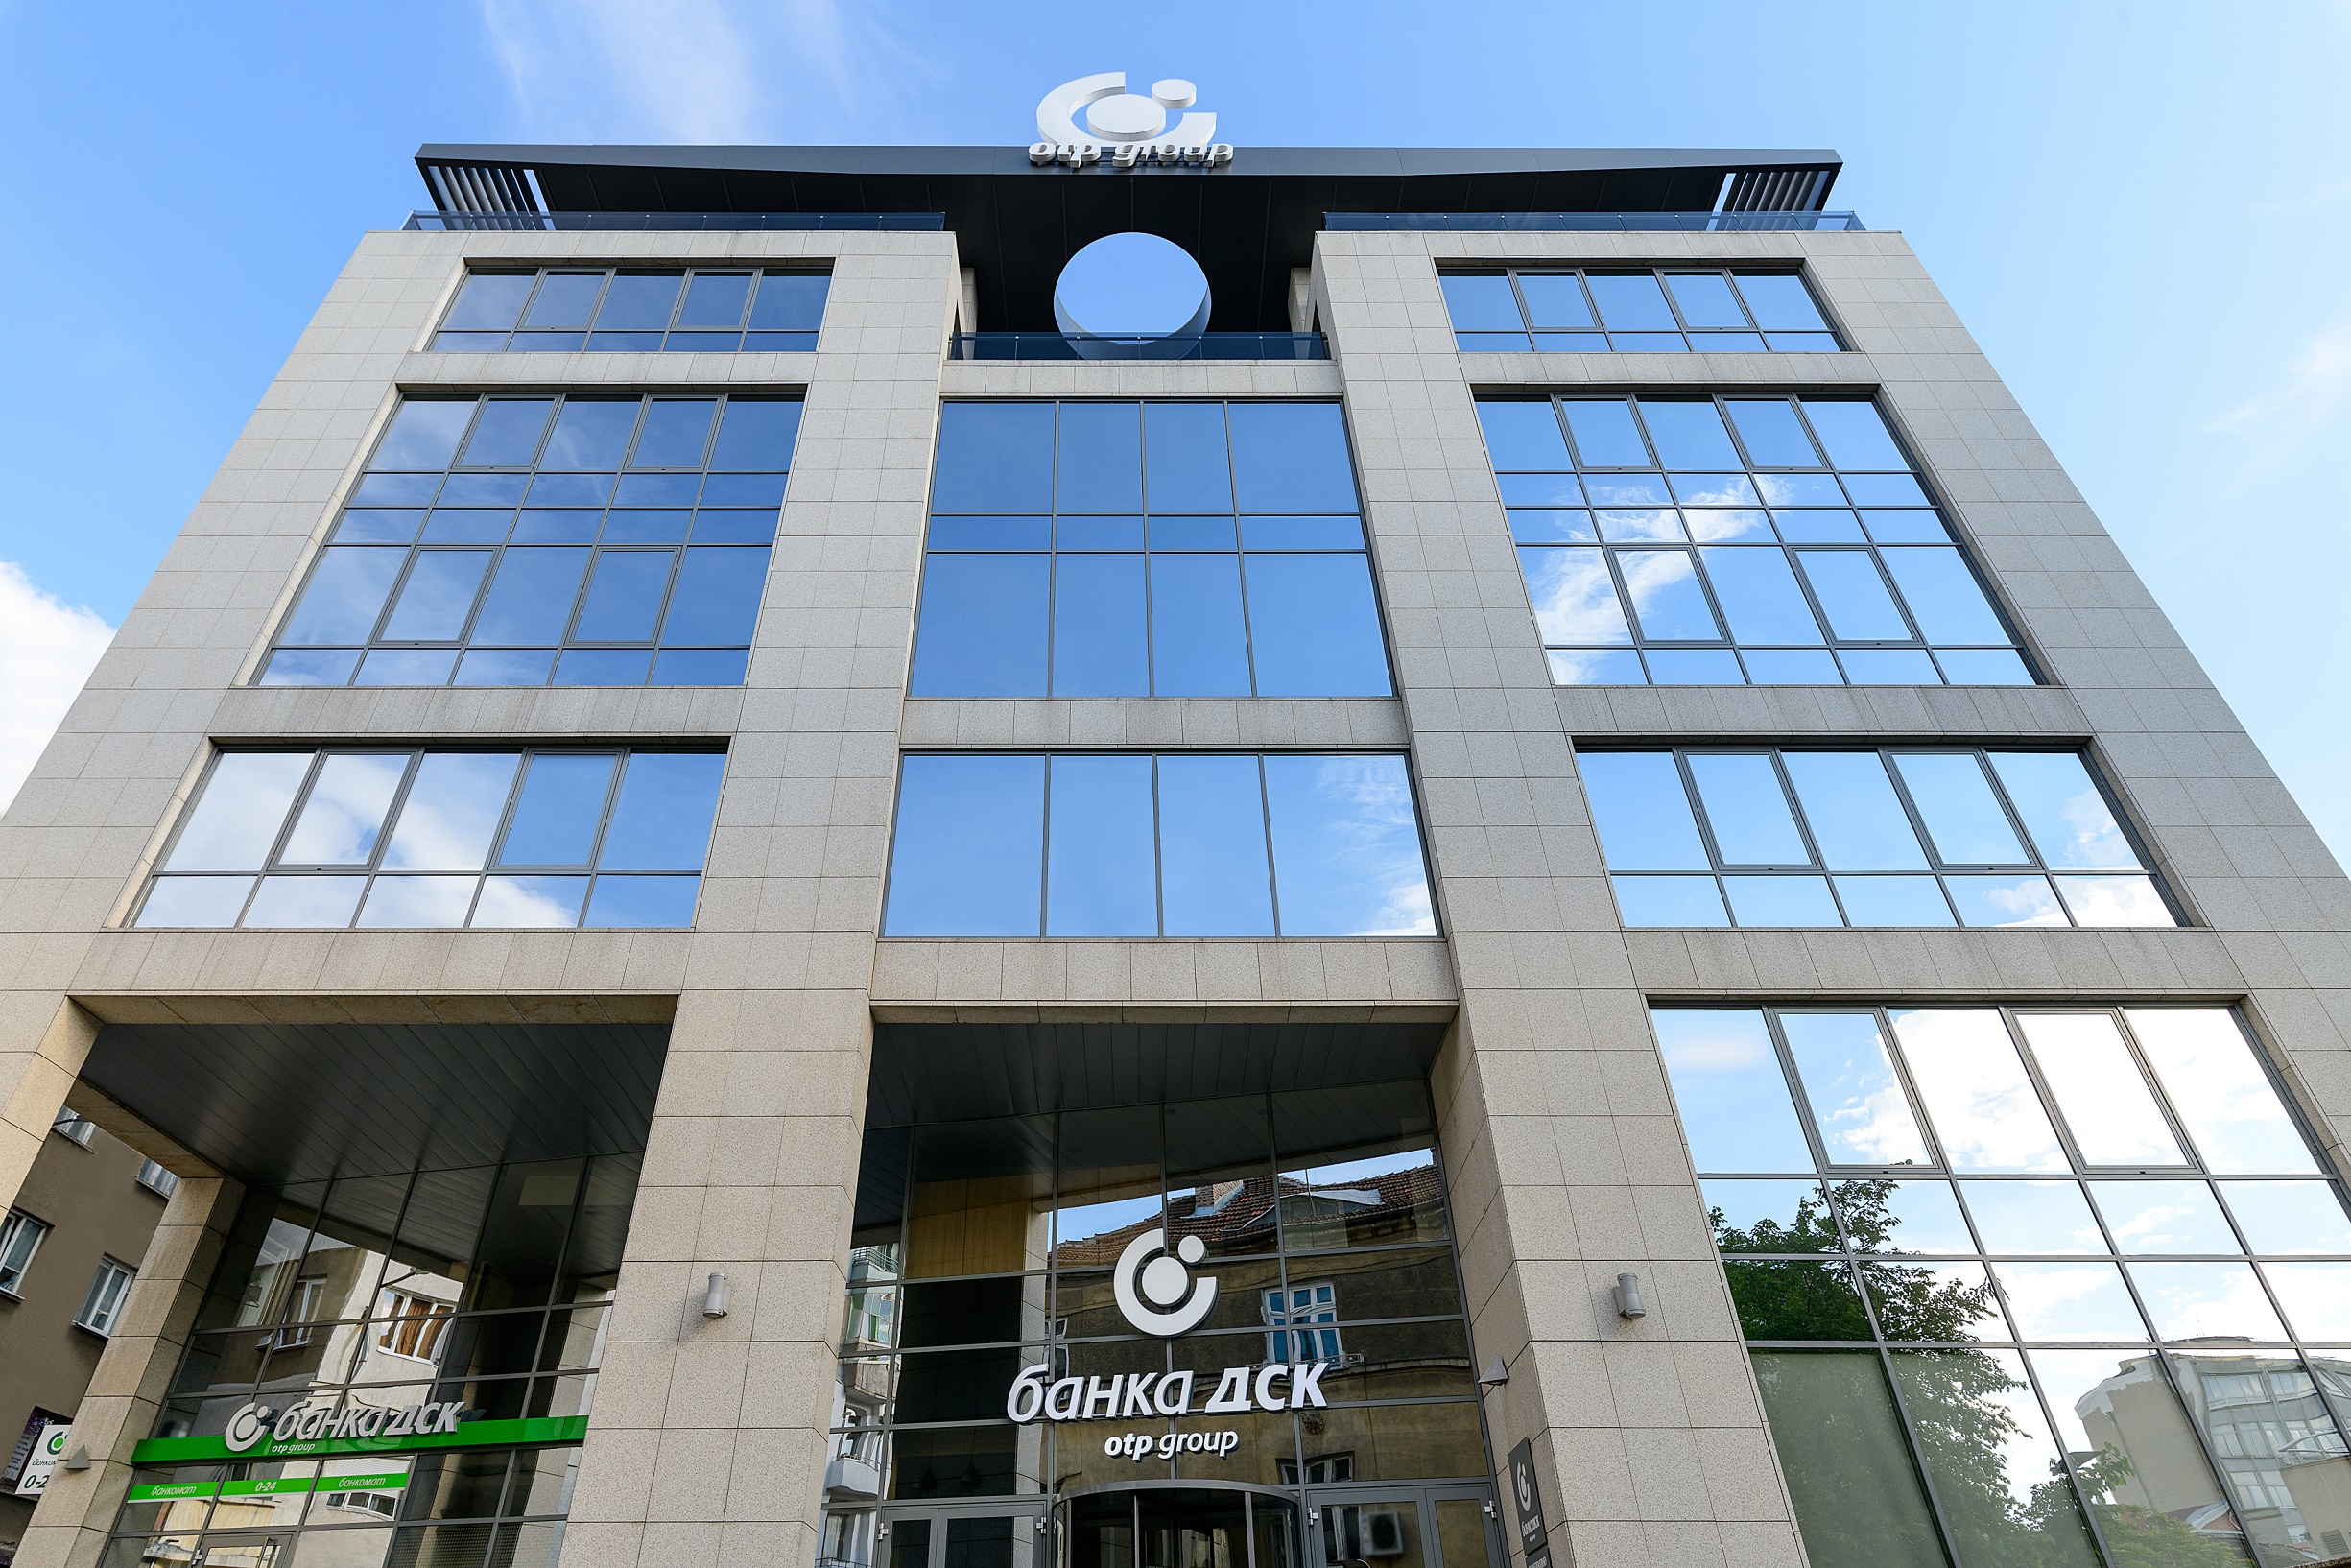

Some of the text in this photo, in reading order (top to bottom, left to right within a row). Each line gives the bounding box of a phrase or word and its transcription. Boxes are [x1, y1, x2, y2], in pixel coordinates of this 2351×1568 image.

[1029, 142, 1234, 169] otp group
[1007, 1363, 1195, 1423] банка
[272, 1442, 316, 1455] otp group
[1104, 1430, 1239, 1461] otp group
[254, 1481, 277, 1492] 0-24
[338, 1477, 387, 1487] банкомат
[151, 1485, 197, 1496] банкомат
